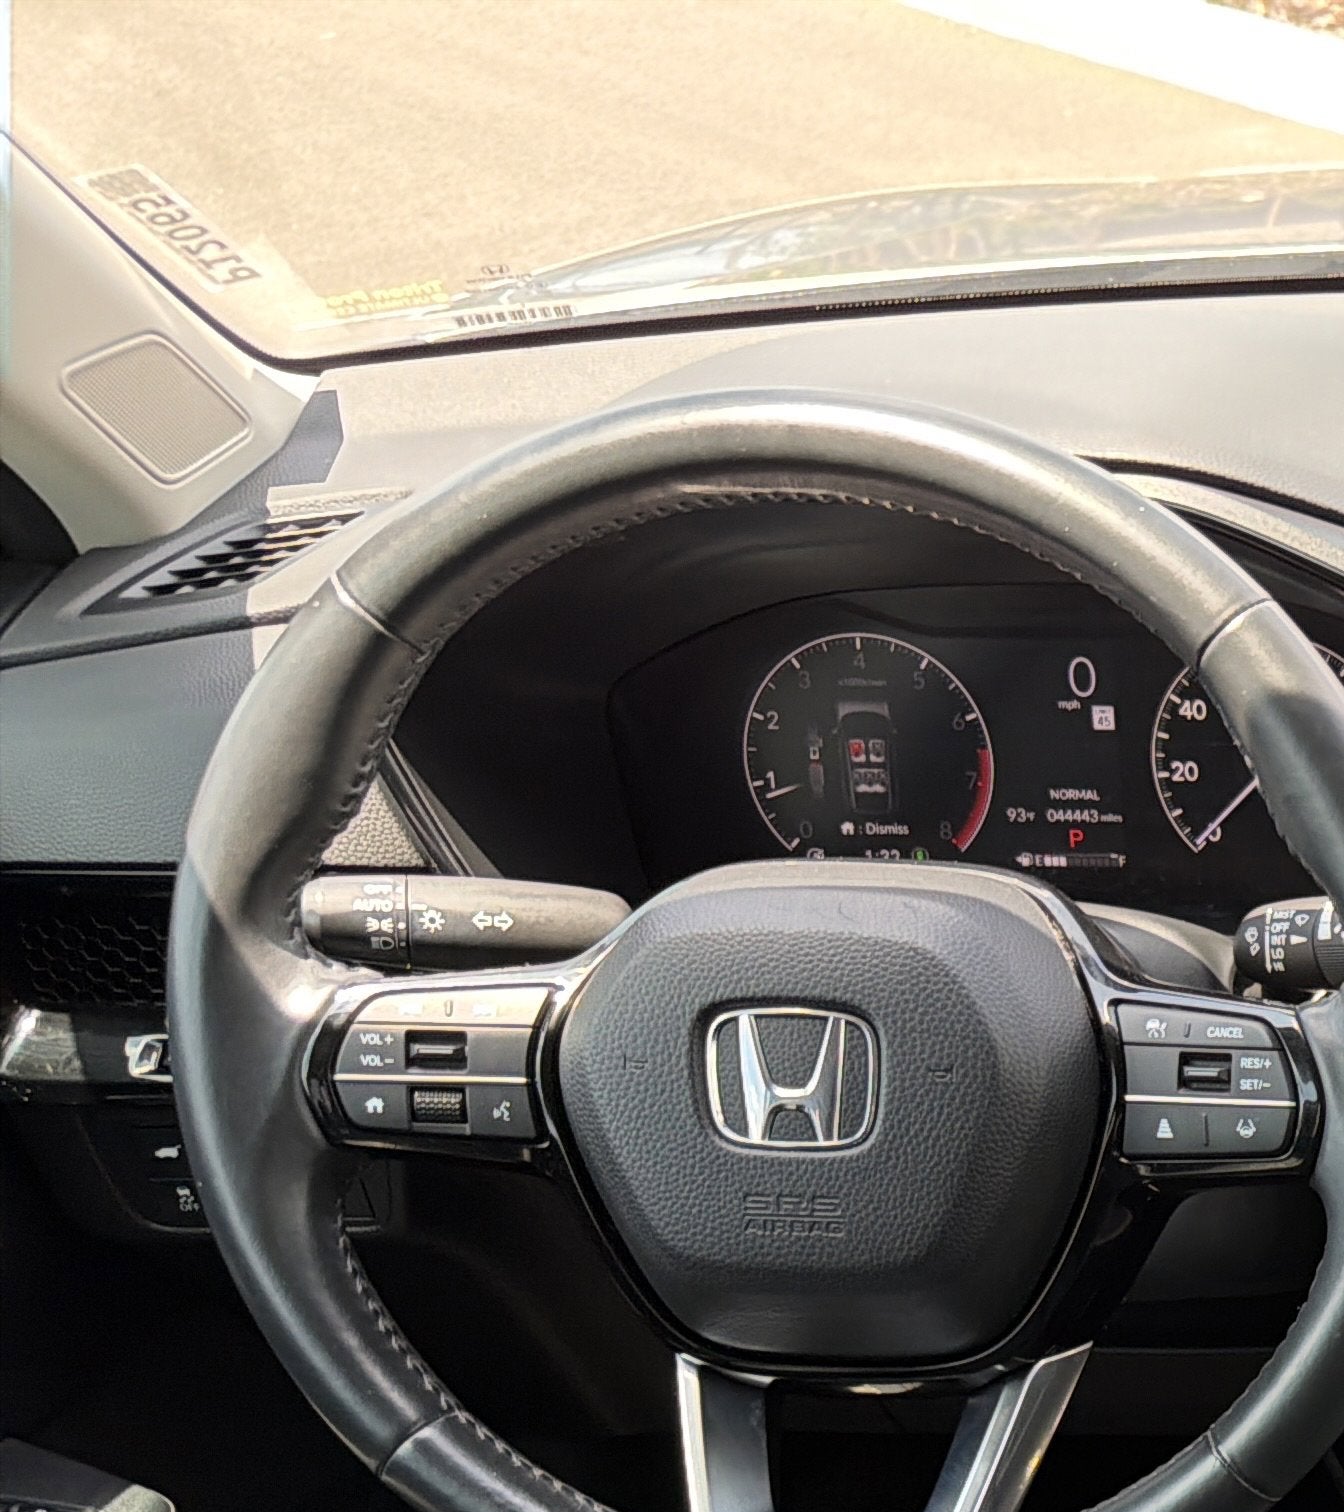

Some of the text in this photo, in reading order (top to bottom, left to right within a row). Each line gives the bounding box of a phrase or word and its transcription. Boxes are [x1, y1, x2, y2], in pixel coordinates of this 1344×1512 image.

[853, 655, 866, 669] 4
[1068, 656, 1096, 698] 0
[1057, 700, 1081, 712] mph
[1178, 700, 1207, 721] 40
[766, 712, 780, 730] 2
[1171, 760, 1199, 782] 20
[765, 770, 775, 789] 1
[1050, 788, 1100, 801] NORMAL
[1046, 808, 1123, 823] 044443 miles
[865, 822, 910, 836] Dismiss
[1068, 829, 1085, 848] P
[1270, 921, 1291, 934] OFF
[1270, 947, 1285, 960] LO
[1206, 1025, 1245, 1039] CANCEL
[1239, 1057, 1273, 1070] RES/+
